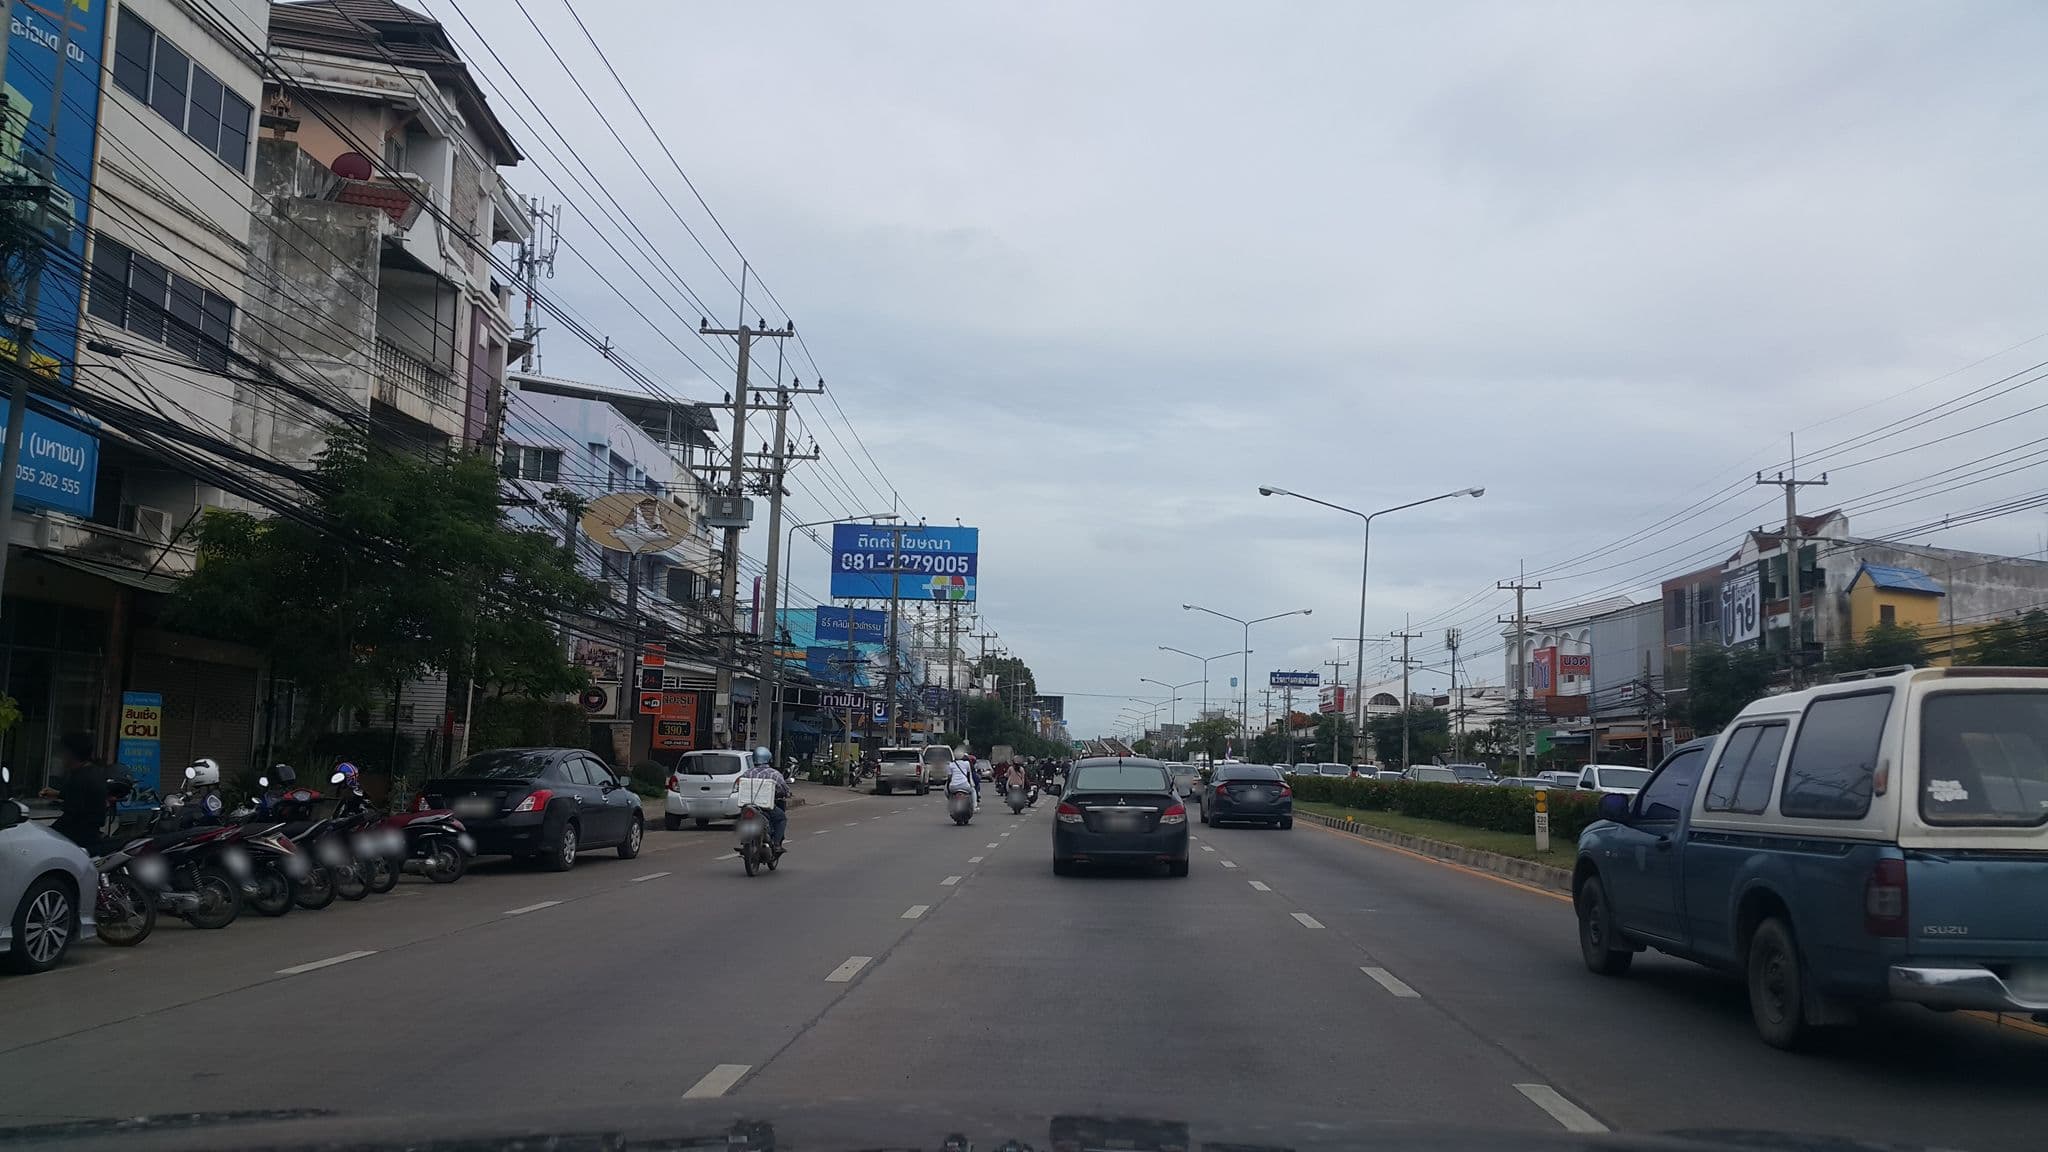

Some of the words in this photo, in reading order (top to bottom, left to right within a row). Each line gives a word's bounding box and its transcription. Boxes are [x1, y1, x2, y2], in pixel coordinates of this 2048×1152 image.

[30, 432, 85, 472] (มหาชน)
[39, 471, 58, 489] 282
[61, 478, 80, 495] 555
[823, 692, 862, 708] ทำฟัน
[125, 707, 158, 721] สินเชื่อ
[124, 720, 158, 737] ด่วน
[1923, 925, 1968, 935] ISUZU
